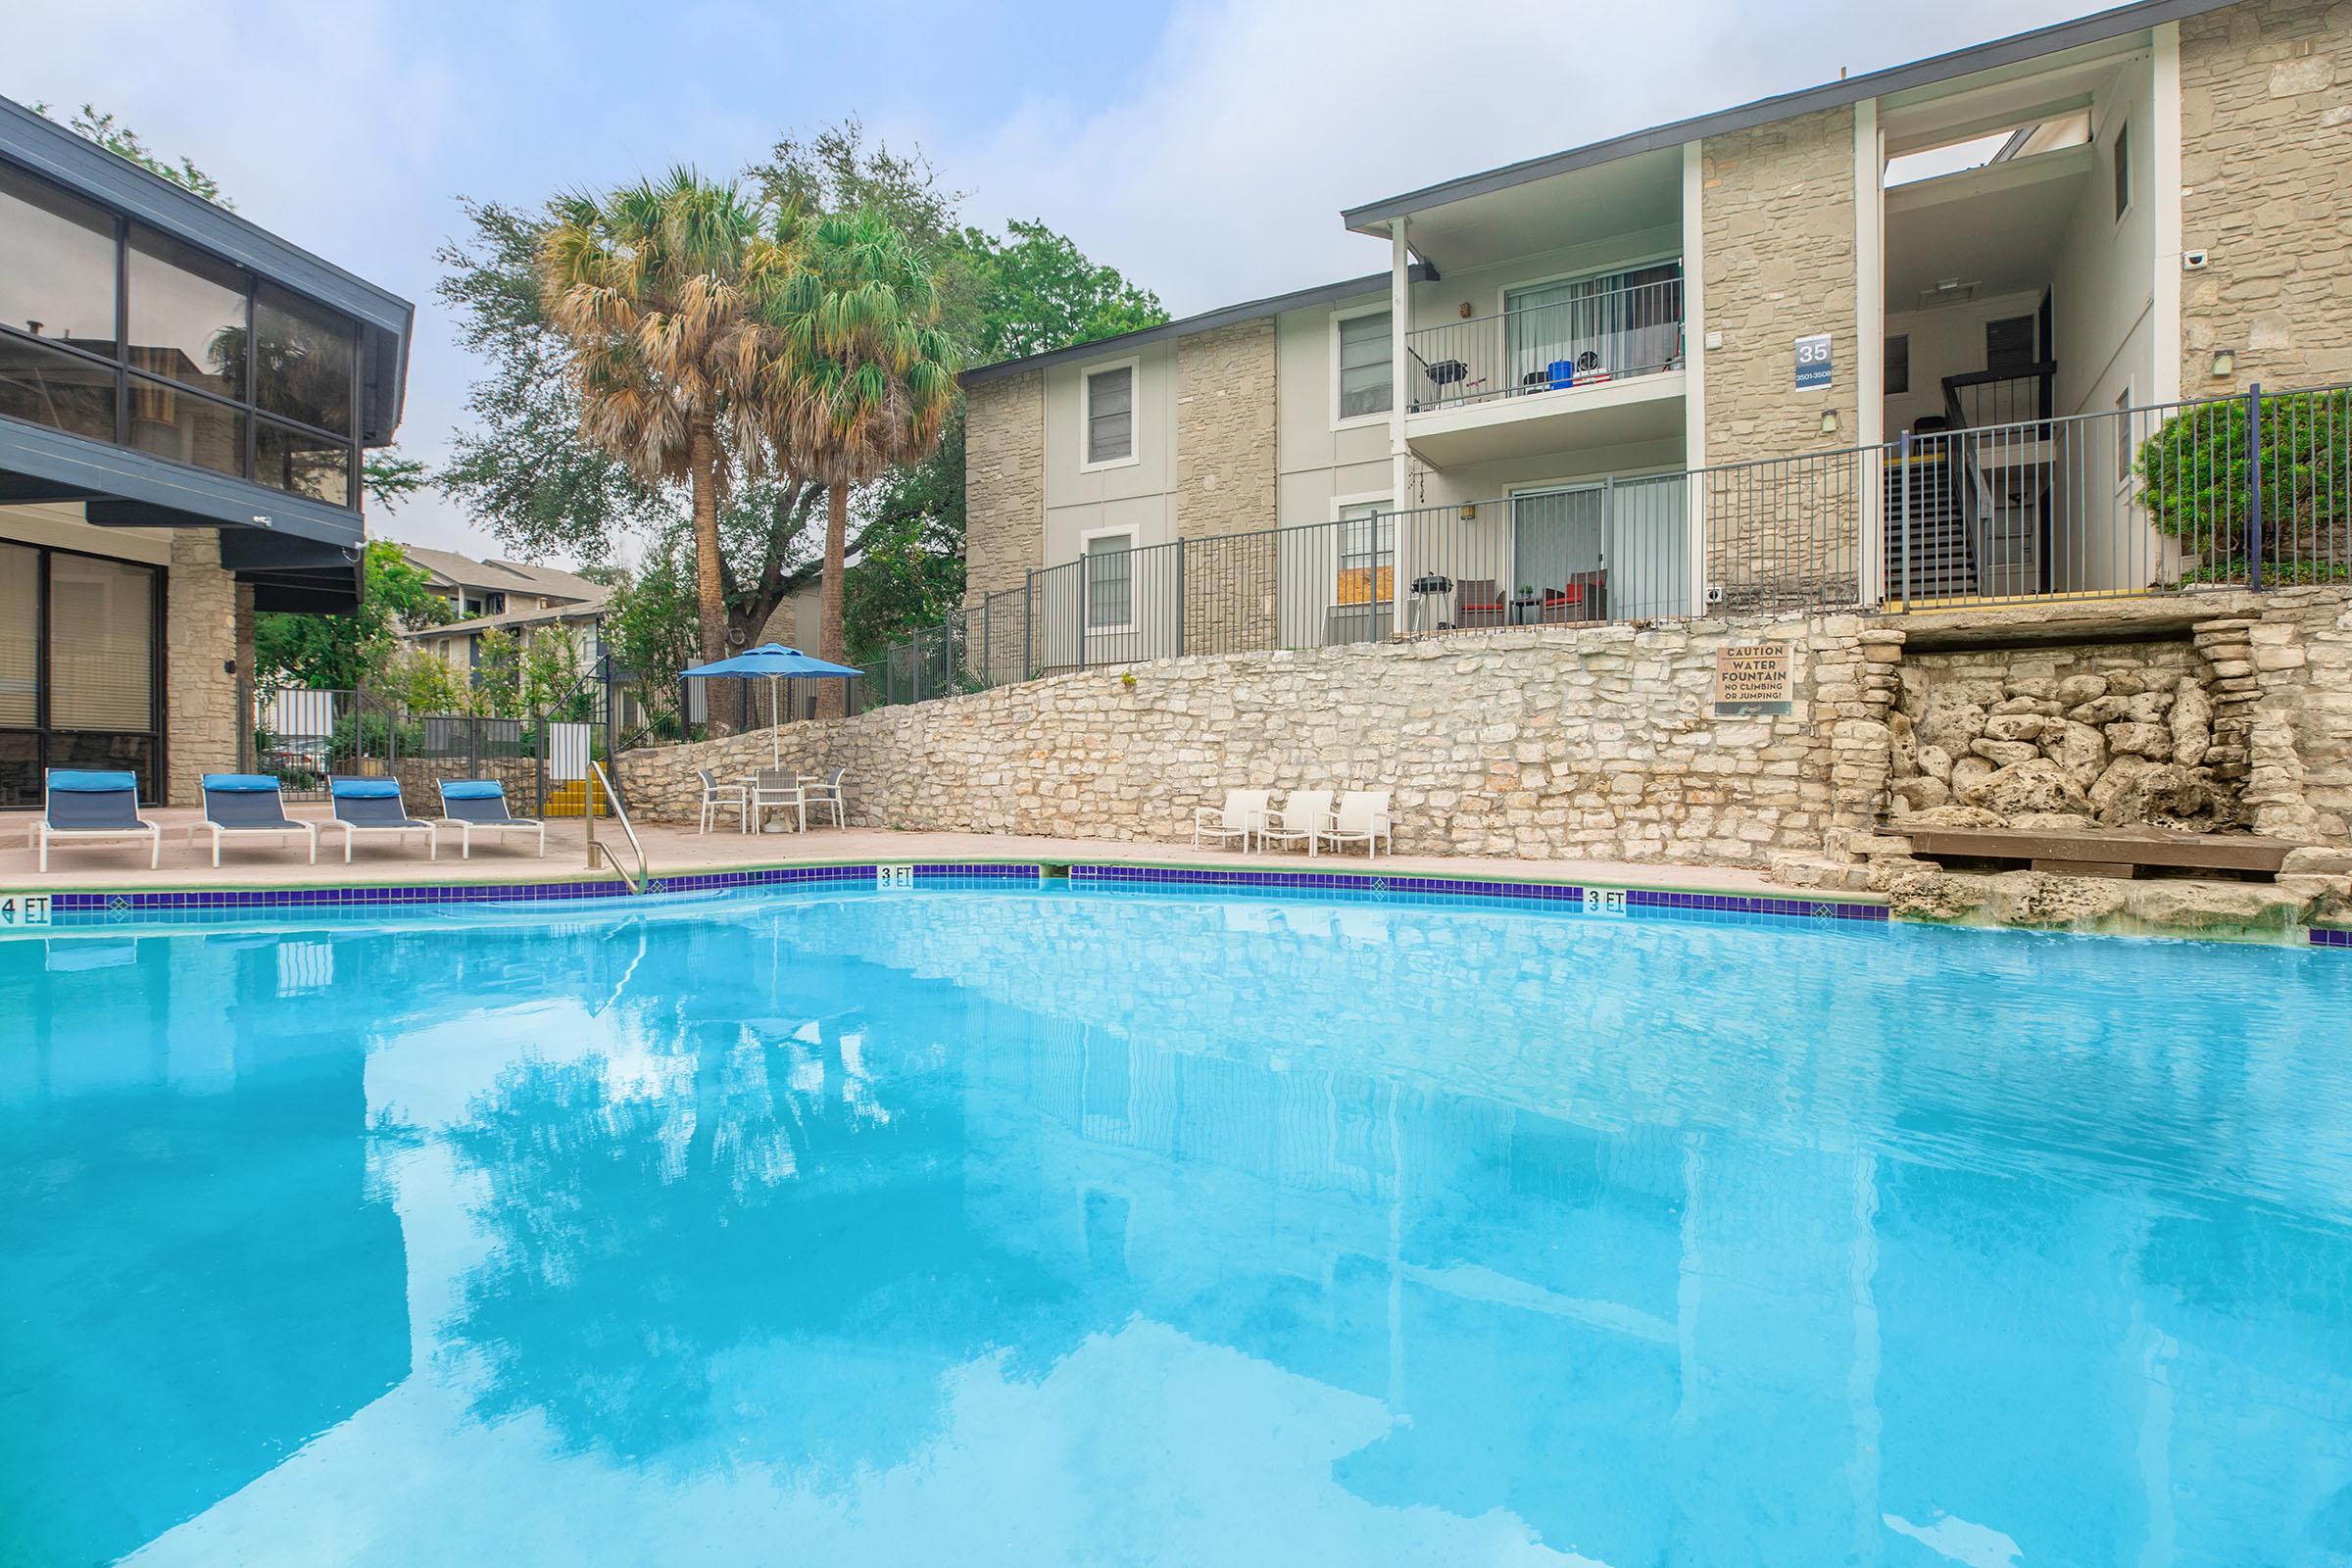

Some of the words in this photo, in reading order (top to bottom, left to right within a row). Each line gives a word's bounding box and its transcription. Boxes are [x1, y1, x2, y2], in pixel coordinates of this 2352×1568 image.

[1799, 343, 1828, 364] 35
[1727, 646, 1784, 658] CAUTION
[1733, 661, 1777, 670] WATER
[1722, 671, 1787, 682] FOUNTAIN
[1740, 682, 1783, 691] CLIMBING
[882, 867, 891, 879] 3
[897, 866, 911, 879] FT
[1589, 890, 1599, 903] 3
[1606, 891, 1625, 904] FT
[2, 898, 16, 912] 4
[24, 898, 48, 912] FT
